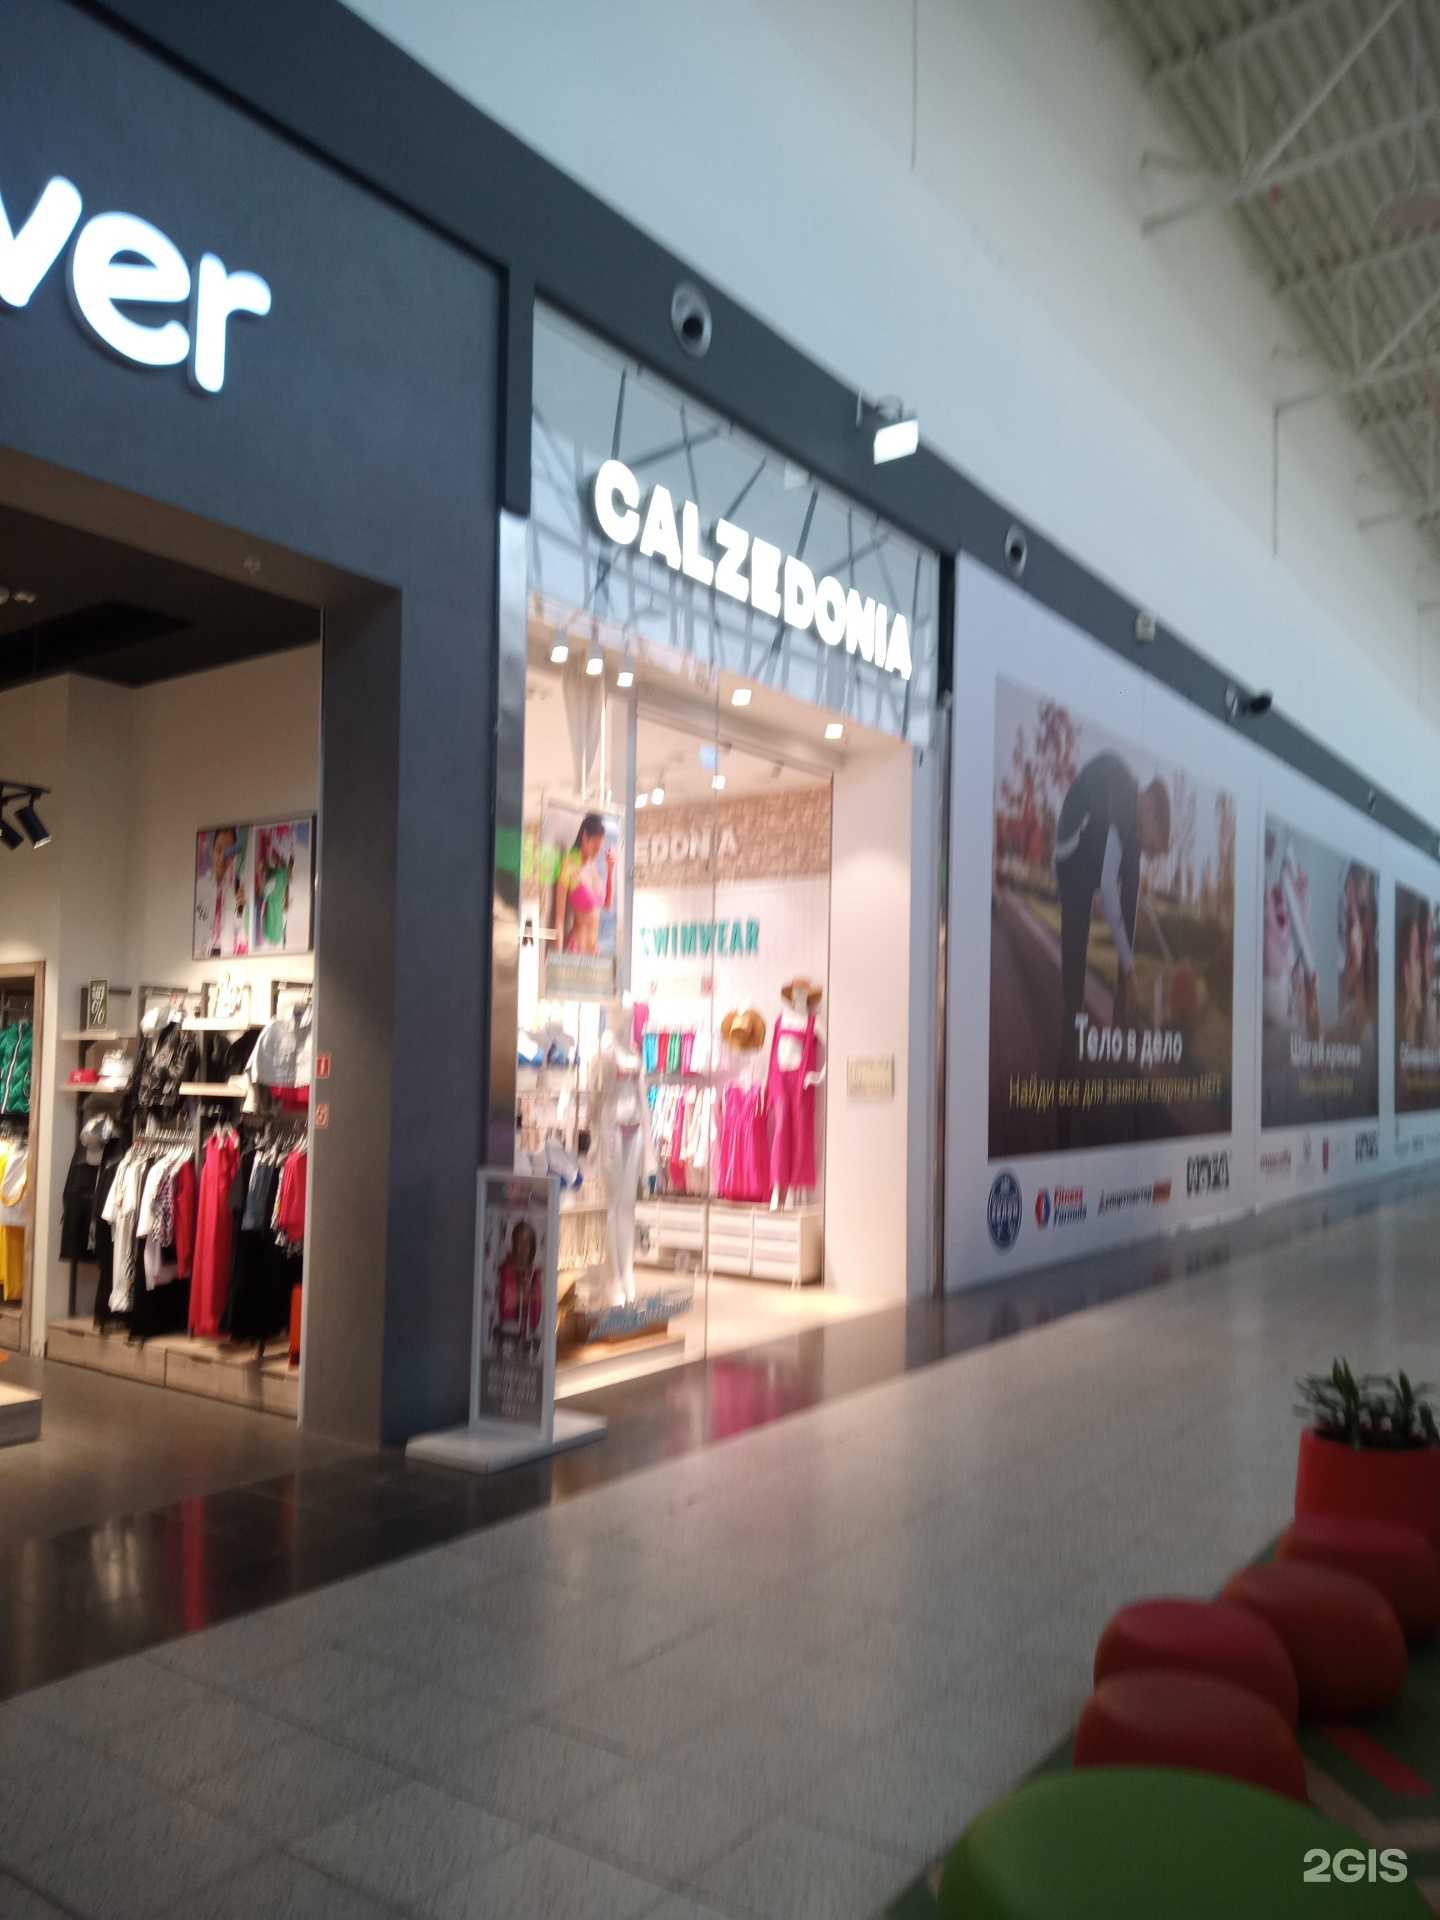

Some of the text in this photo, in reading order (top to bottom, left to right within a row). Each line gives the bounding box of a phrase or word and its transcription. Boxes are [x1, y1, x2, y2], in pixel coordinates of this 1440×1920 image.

[594, 459, 912, 680] CALZEDONIA
[1074, 1012, 1183, 1068] Тело в дело
[1009, 1072, 1056, 1114] Найди
[1058, 1078, 1080, 1107] все
[1082, 1078, 1104, 1111] для
